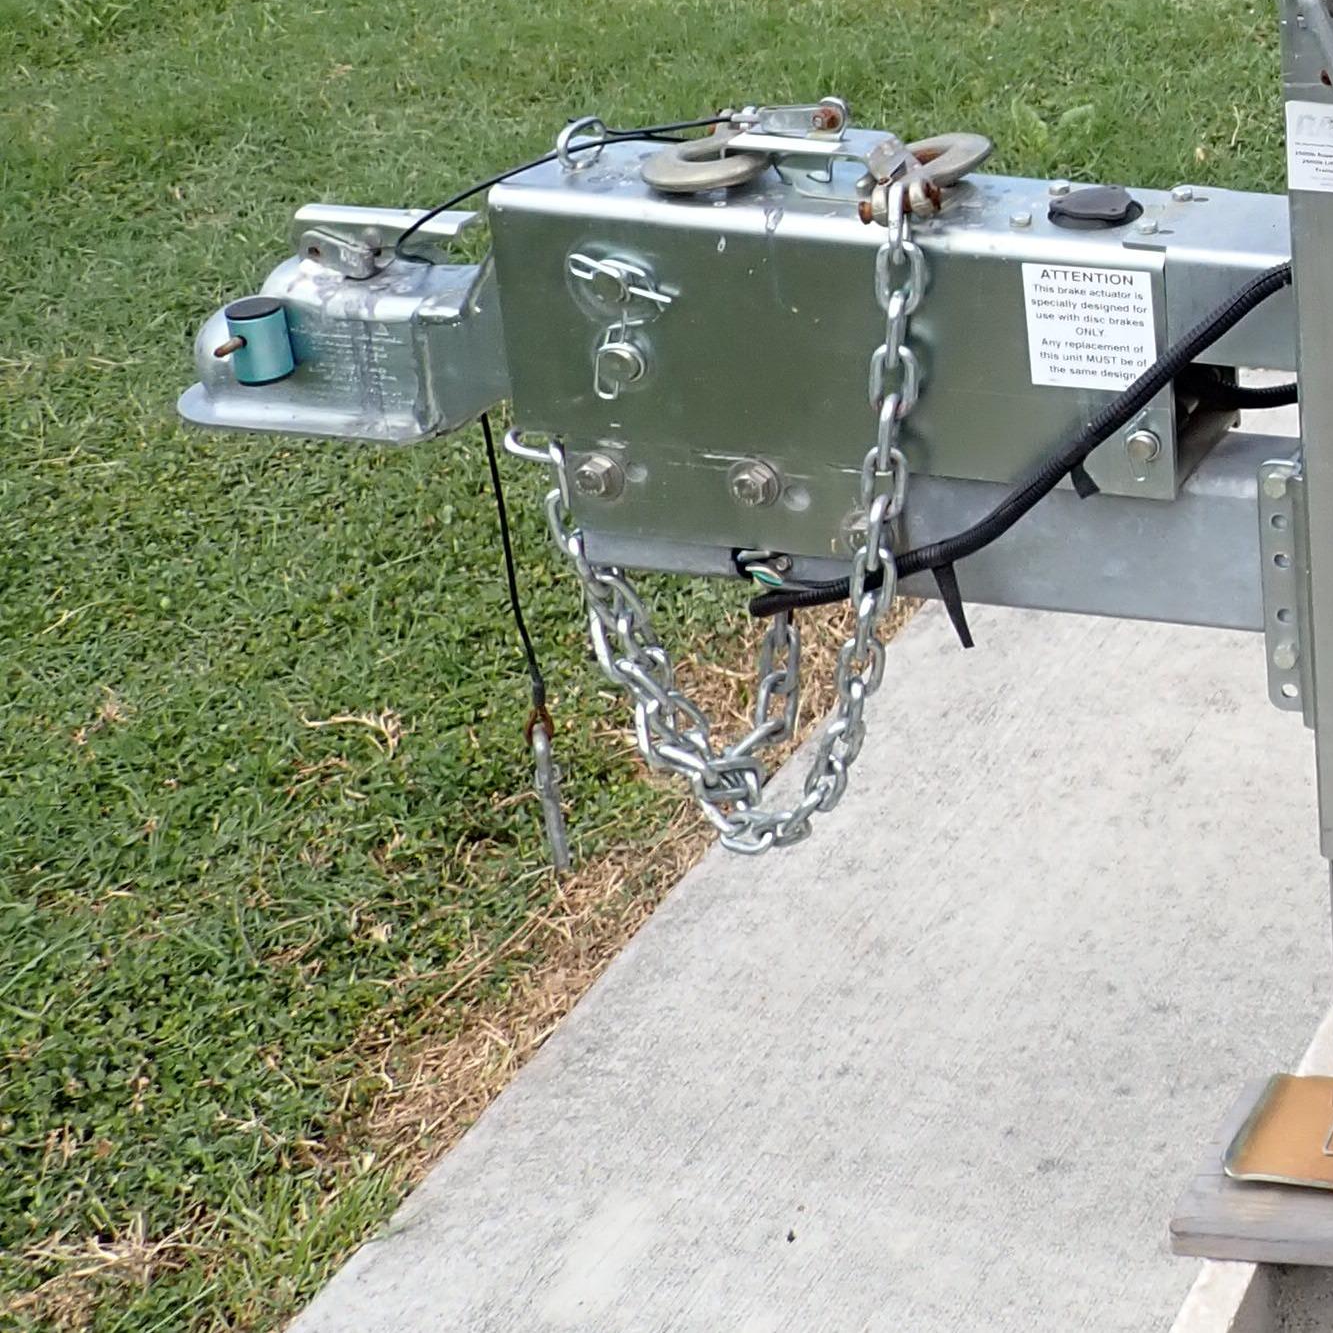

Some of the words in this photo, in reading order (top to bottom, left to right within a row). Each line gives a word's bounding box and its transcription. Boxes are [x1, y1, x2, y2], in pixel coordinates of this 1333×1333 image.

[1041, 269, 1133, 286] ATTENTION
[1034, 284, 1054, 294] This
[1057, 287, 1086, 296] brake
[1089, 289, 1131, 298] actuator
[1134, 291, 1143, 300] is
[1031, 298, 1077, 311] specially
[1081, 301, 1129, 315] designed
[1133, 305, 1147, 313] for
[1036, 312, 1055, 320] use
[1058, 313, 1080, 322] with
[1083, 315, 1105, 324] disc
[1109, 317, 1144, 327] brakes
[1075, 327, 1104, 337] ONLY
[1042, 338, 1061, 349] Any
[1065, 339, 1130, 353] replacement
[1133, 345, 1143, 353] of
[1040, 351, 1059, 360] this
[1063, 354, 1082, 362] unit
[1086, 355, 1117, 365] MUST
[1120, 357, 1133, 366] be
[1137, 359, 1147, 367] of
[1049, 365, 1066, 374] the
[1069, 368, 1097, 376] same
[1101, 369, 1136, 380] design
